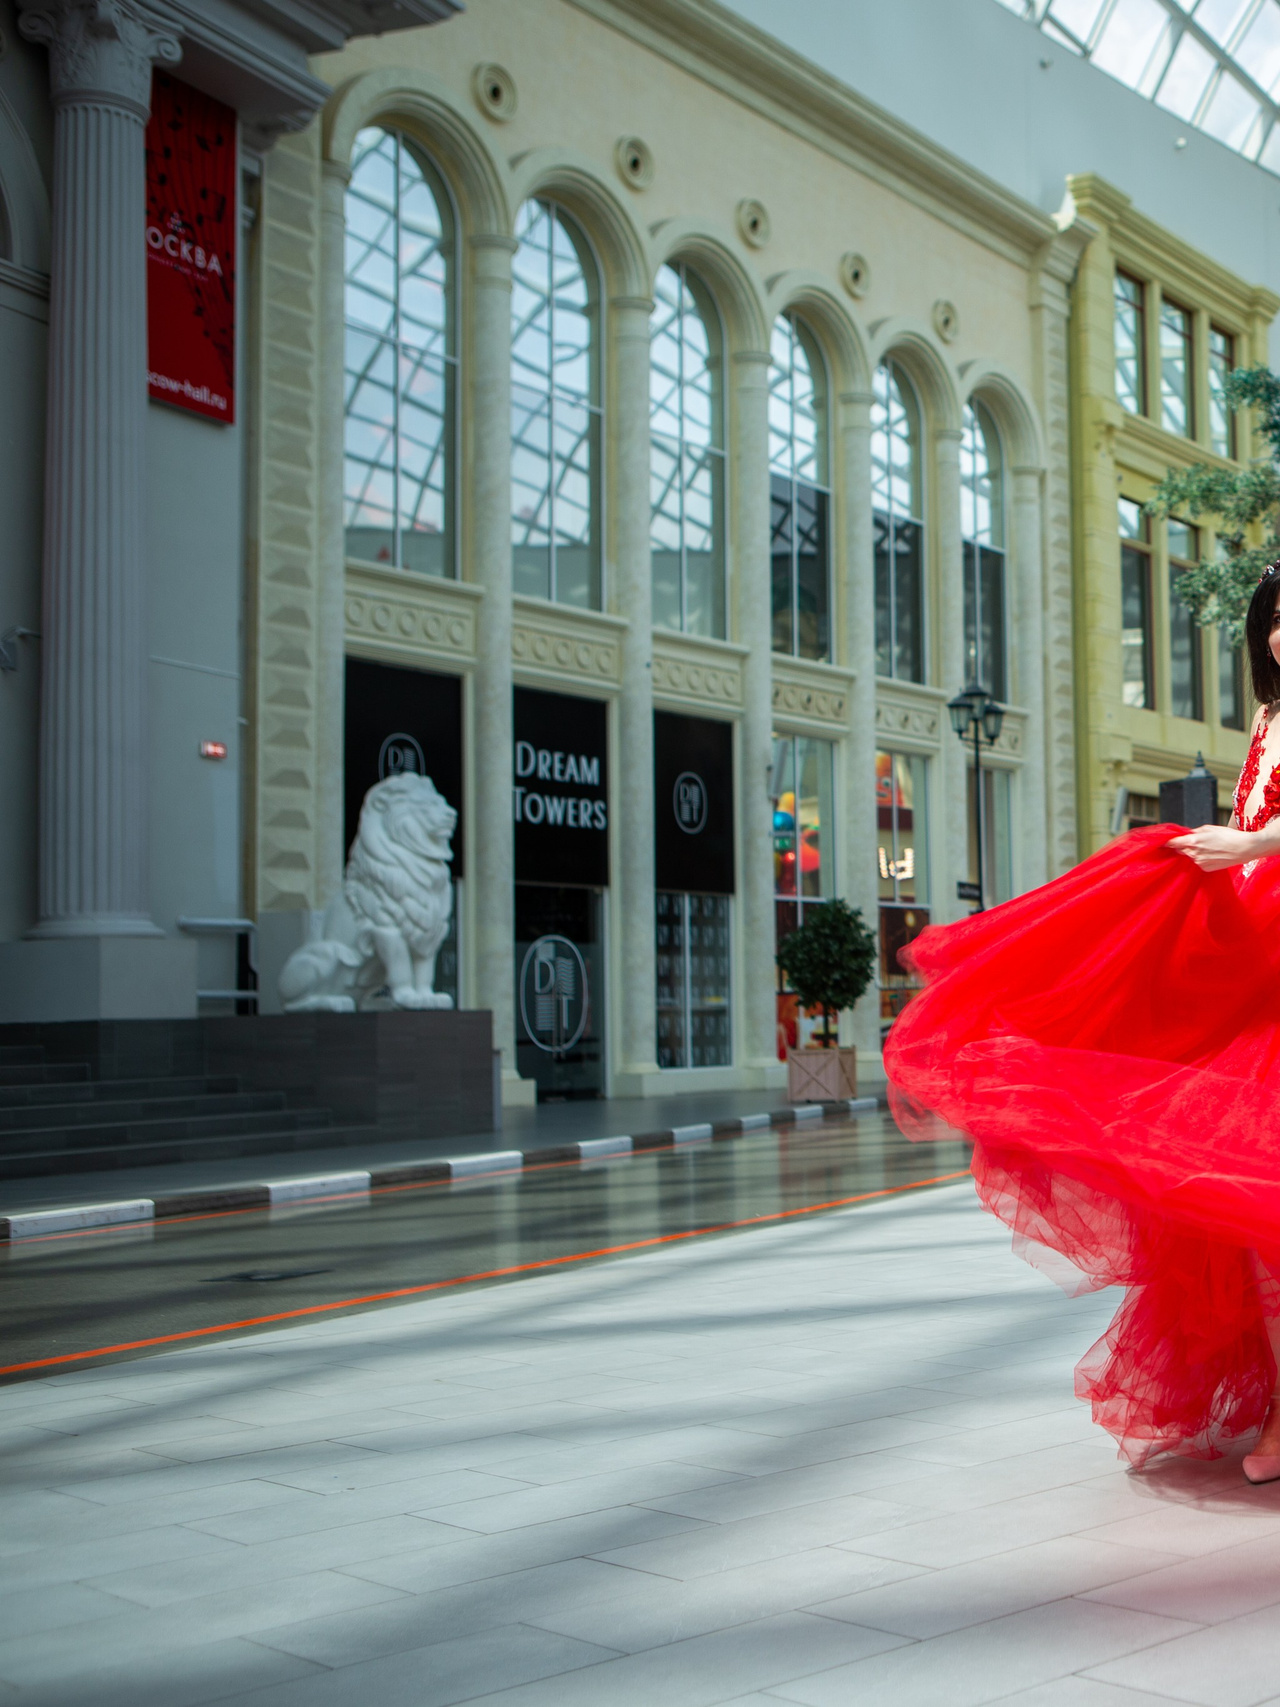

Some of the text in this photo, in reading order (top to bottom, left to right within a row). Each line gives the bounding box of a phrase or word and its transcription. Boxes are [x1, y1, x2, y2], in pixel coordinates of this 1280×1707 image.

[146, 226, 223, 277] ОСКВА
[516, 740, 600, 786] DREAM
[513, 786, 607, 830] TOWERS
